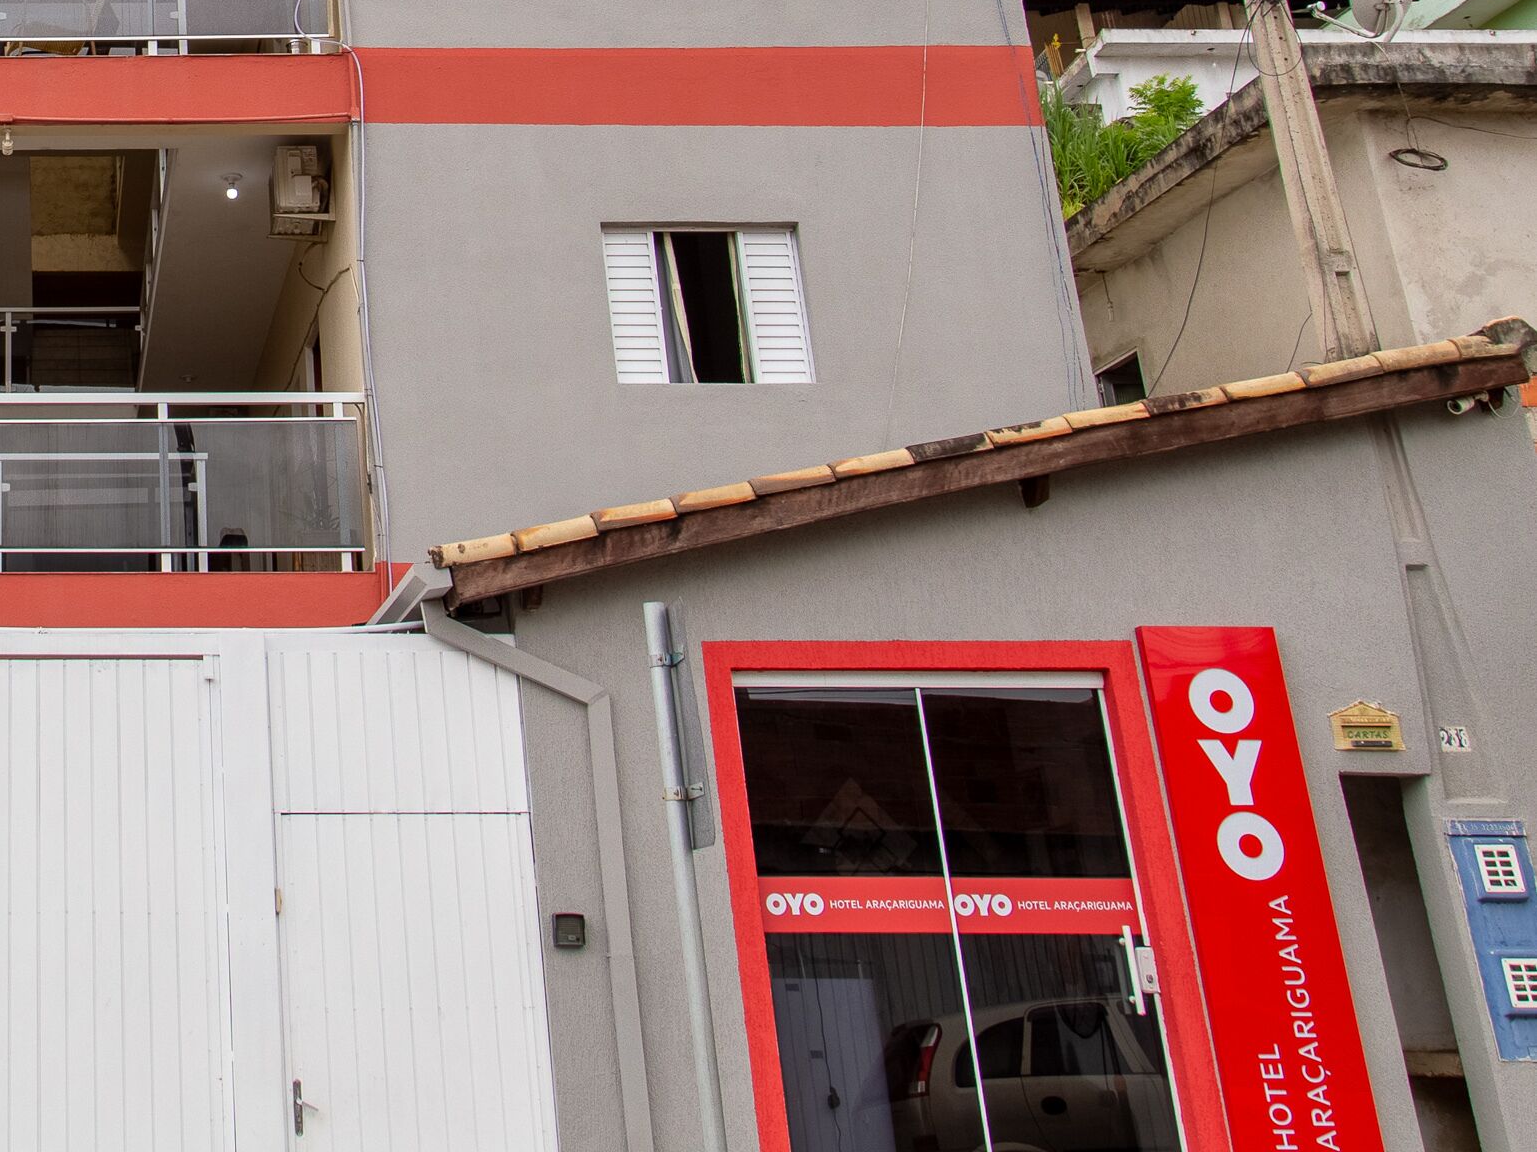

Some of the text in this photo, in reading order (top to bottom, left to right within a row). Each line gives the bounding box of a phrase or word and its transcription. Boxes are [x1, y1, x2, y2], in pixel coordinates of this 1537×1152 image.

[1347, 730, 1389, 740] CARTAS
[1188, 668, 1285, 881] OYO
[766, 892, 945, 916] OYO HOTEL ARAÇARIGUAMA
[954, 893, 1134, 917] OYO HOTEL ARAÇARIGUAMA
[1268, 894, 1341, 1152] ARAÇARIGUAMA
[1258, 1043, 1299, 1151] HOTEL
